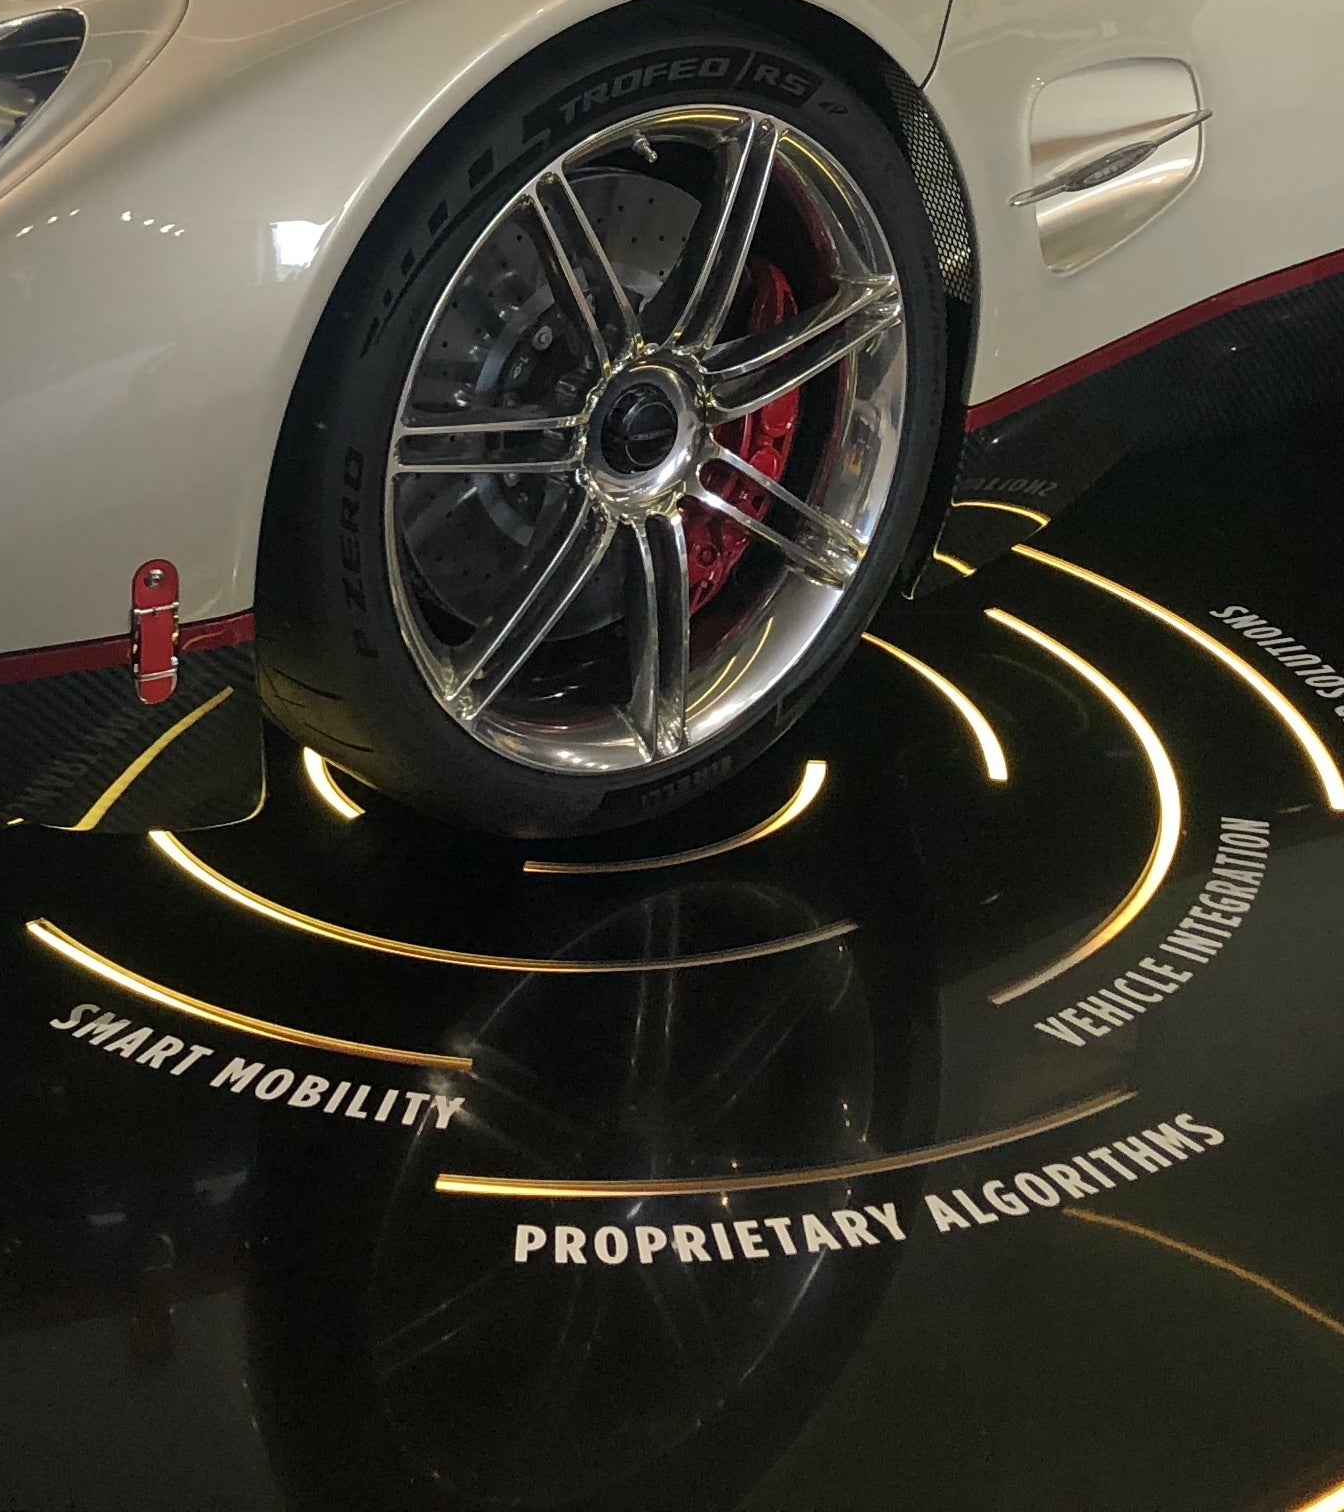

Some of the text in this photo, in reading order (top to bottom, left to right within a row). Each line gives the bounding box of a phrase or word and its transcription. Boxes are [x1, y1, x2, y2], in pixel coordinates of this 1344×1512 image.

[559, 57, 811, 124] TROFEO RS
[1034, 816, 1270, 1048] VEHICLE INTEGRATION
[49, 1003, 466, 1130] SMART MOBILITY
[514, 1112, 1225, 1265] PROPRIETARY ALGORITHMS
